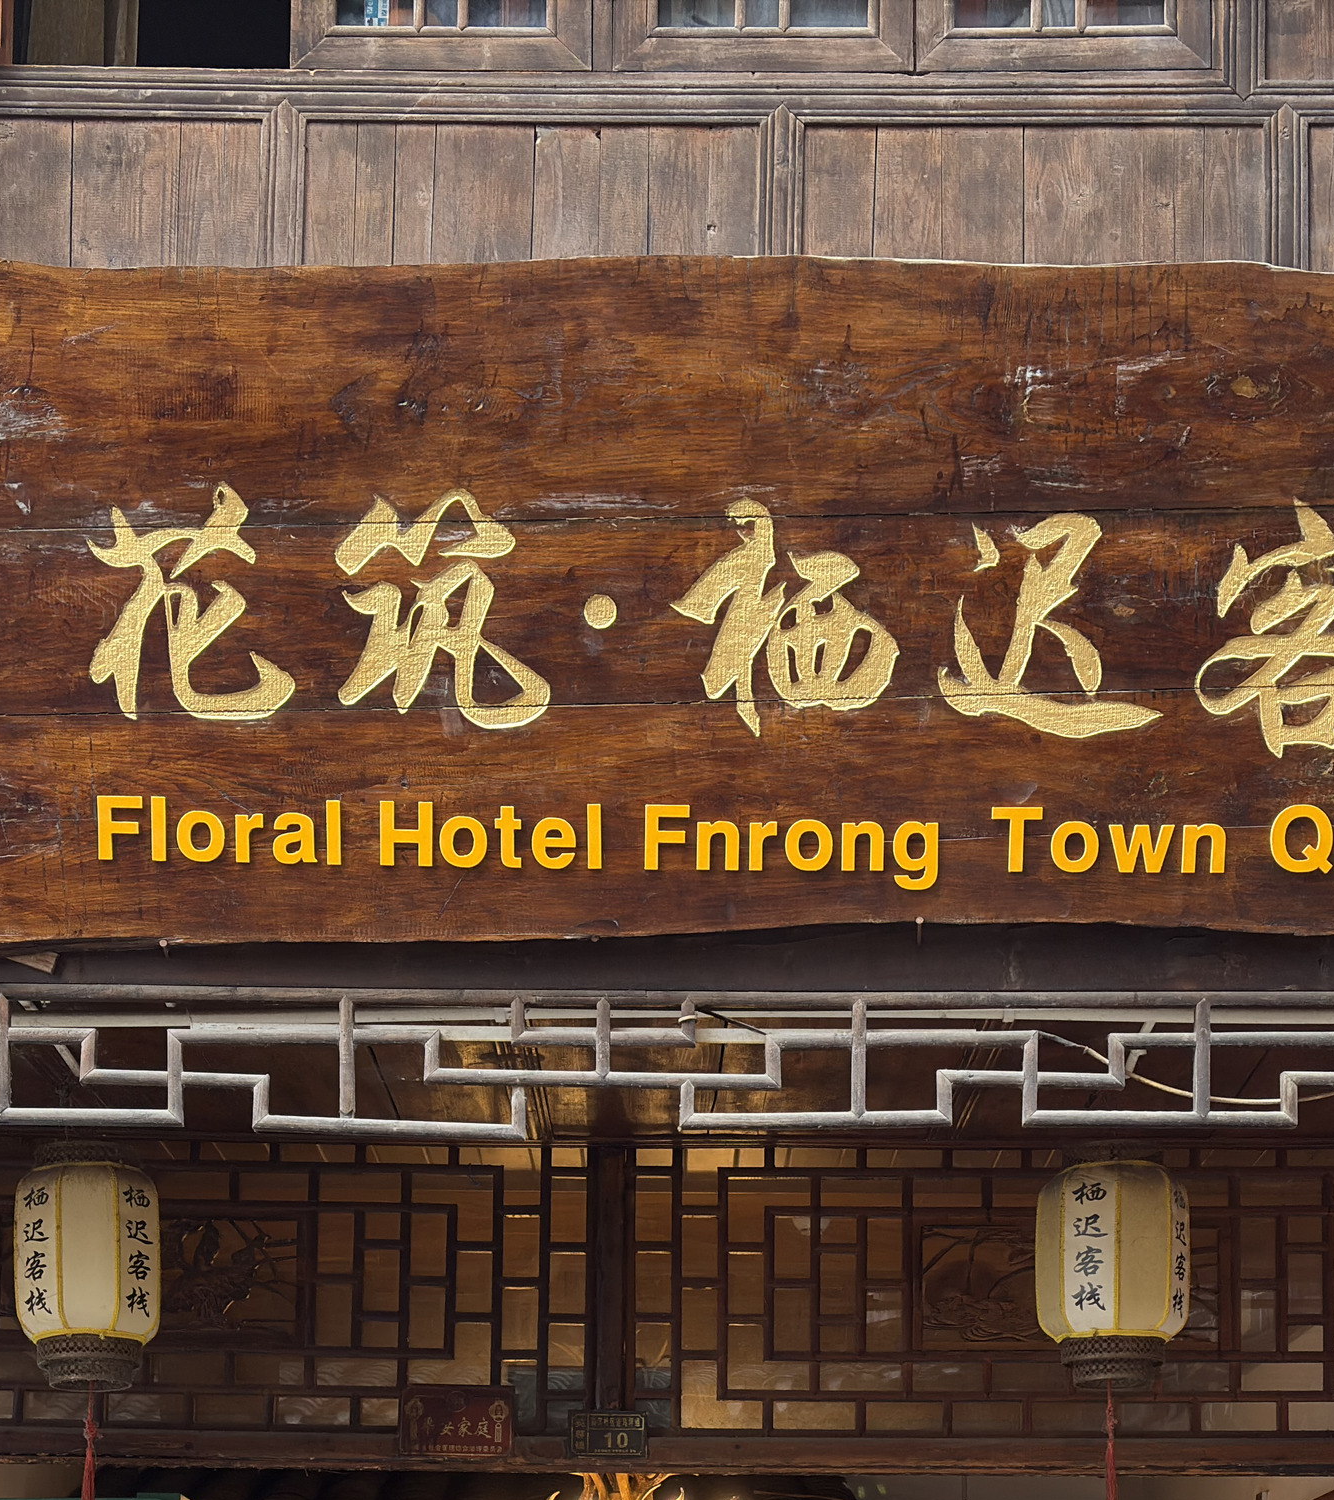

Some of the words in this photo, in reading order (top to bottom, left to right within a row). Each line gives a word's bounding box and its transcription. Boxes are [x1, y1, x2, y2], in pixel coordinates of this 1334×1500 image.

[96, 794, 342, 866] Floral
[378, 801, 603, 871] Hotel
[643, 804, 940, 891] Fnrong
[991, 806, 1227, 874] Town
[23, 1186, 52, 1316] 栖迟客栈
[123, 1185, 154, 1318] 栖迟客栈
[1071, 1183, 1108, 1311] 栖迟客栈
[604, 1432, 629, 1448] 10
